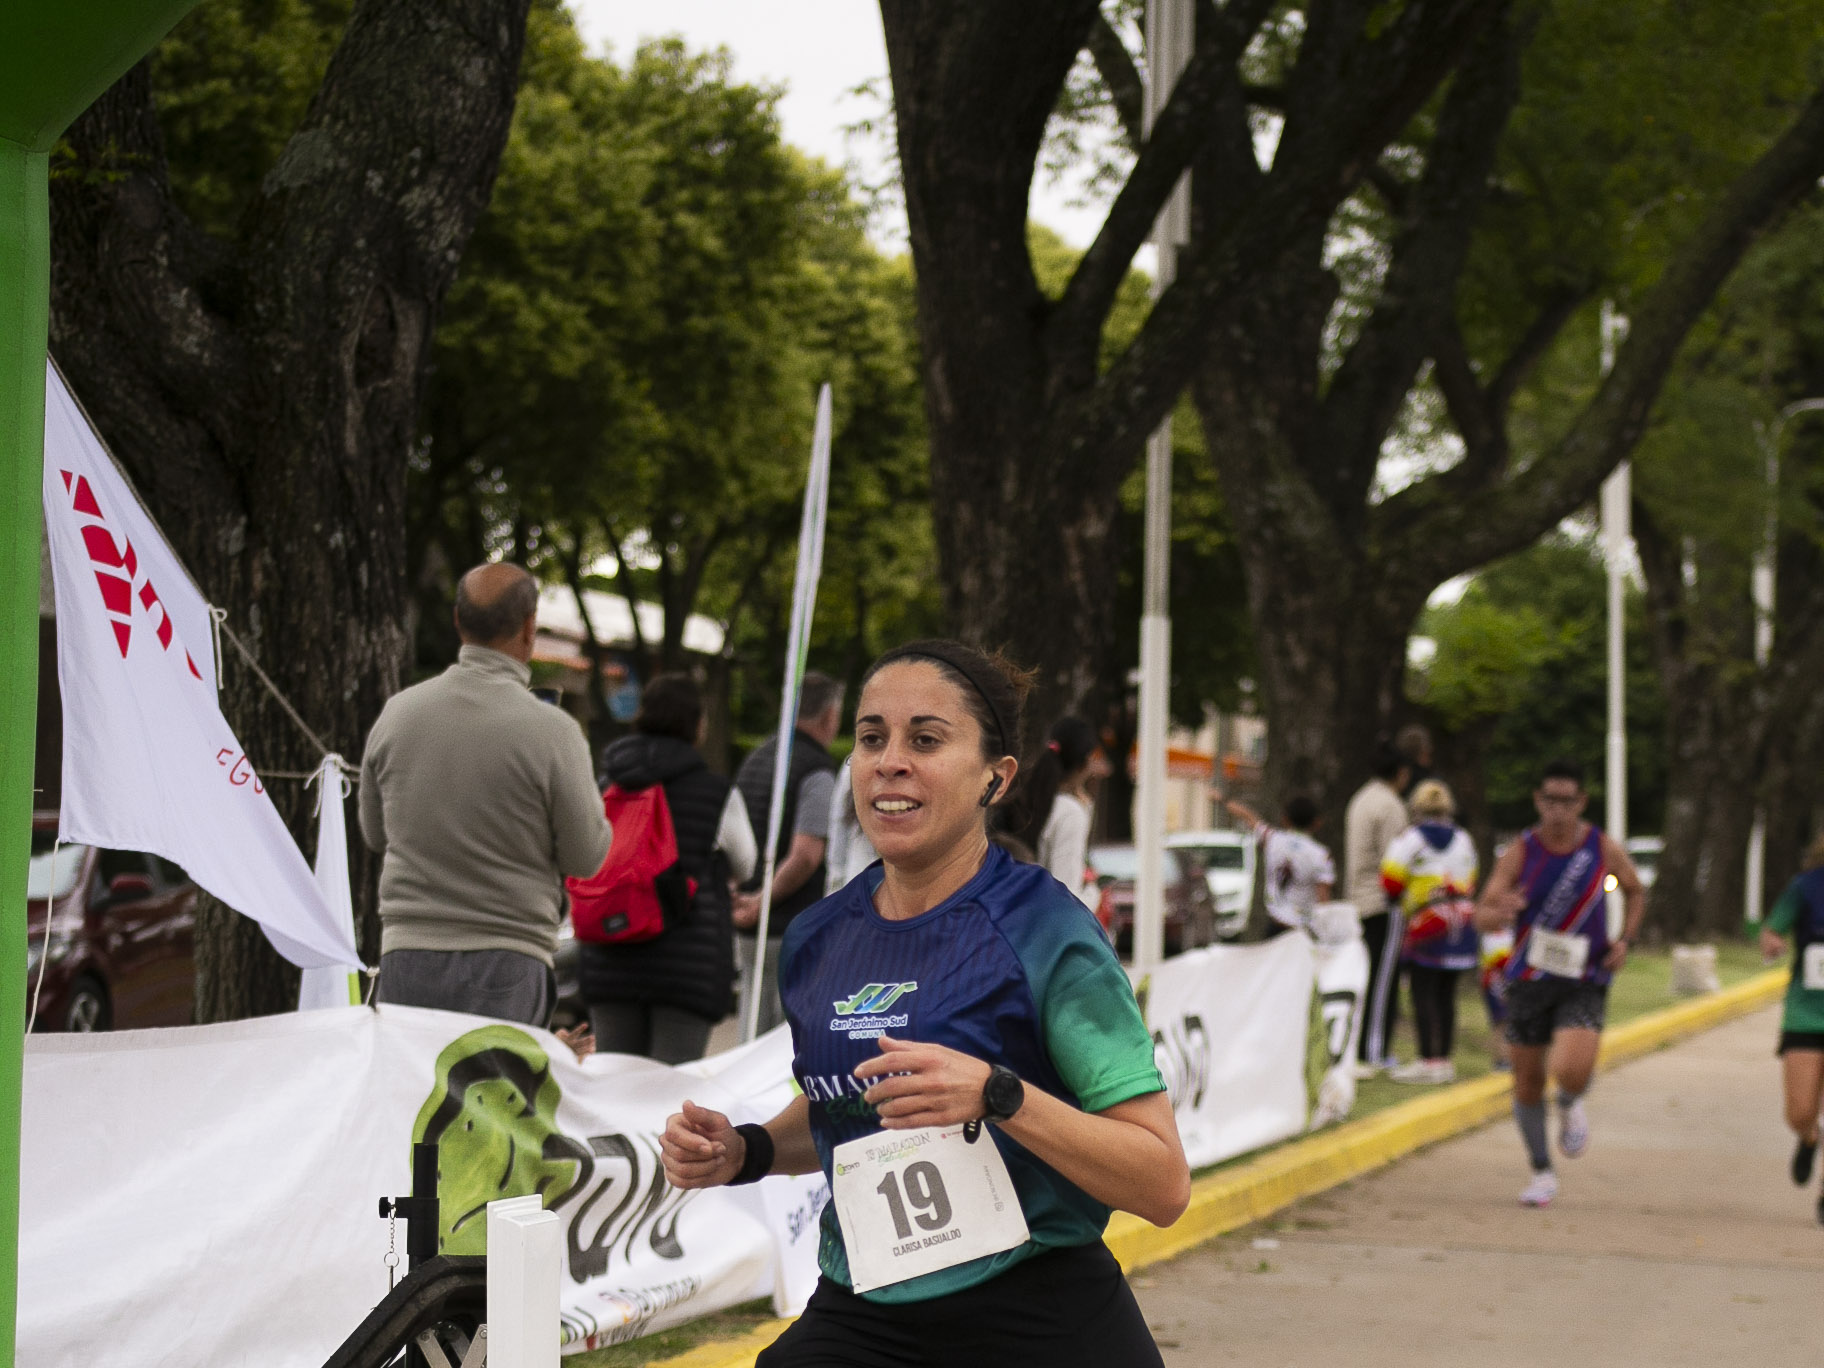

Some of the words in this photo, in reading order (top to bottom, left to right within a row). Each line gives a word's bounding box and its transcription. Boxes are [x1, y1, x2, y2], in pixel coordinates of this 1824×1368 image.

[831, 1018, 848, 1031] San
[849, 1015, 888, 1030] Jerónimo
[890, 1014, 908, 1027] Sud
[849, 1030, 886, 1039] COMUNA
[876, 1160, 953, 1240] 19
[893, 1240, 923, 1257] CLARISA
[924, 1228, 962, 1248] BASUALDO
